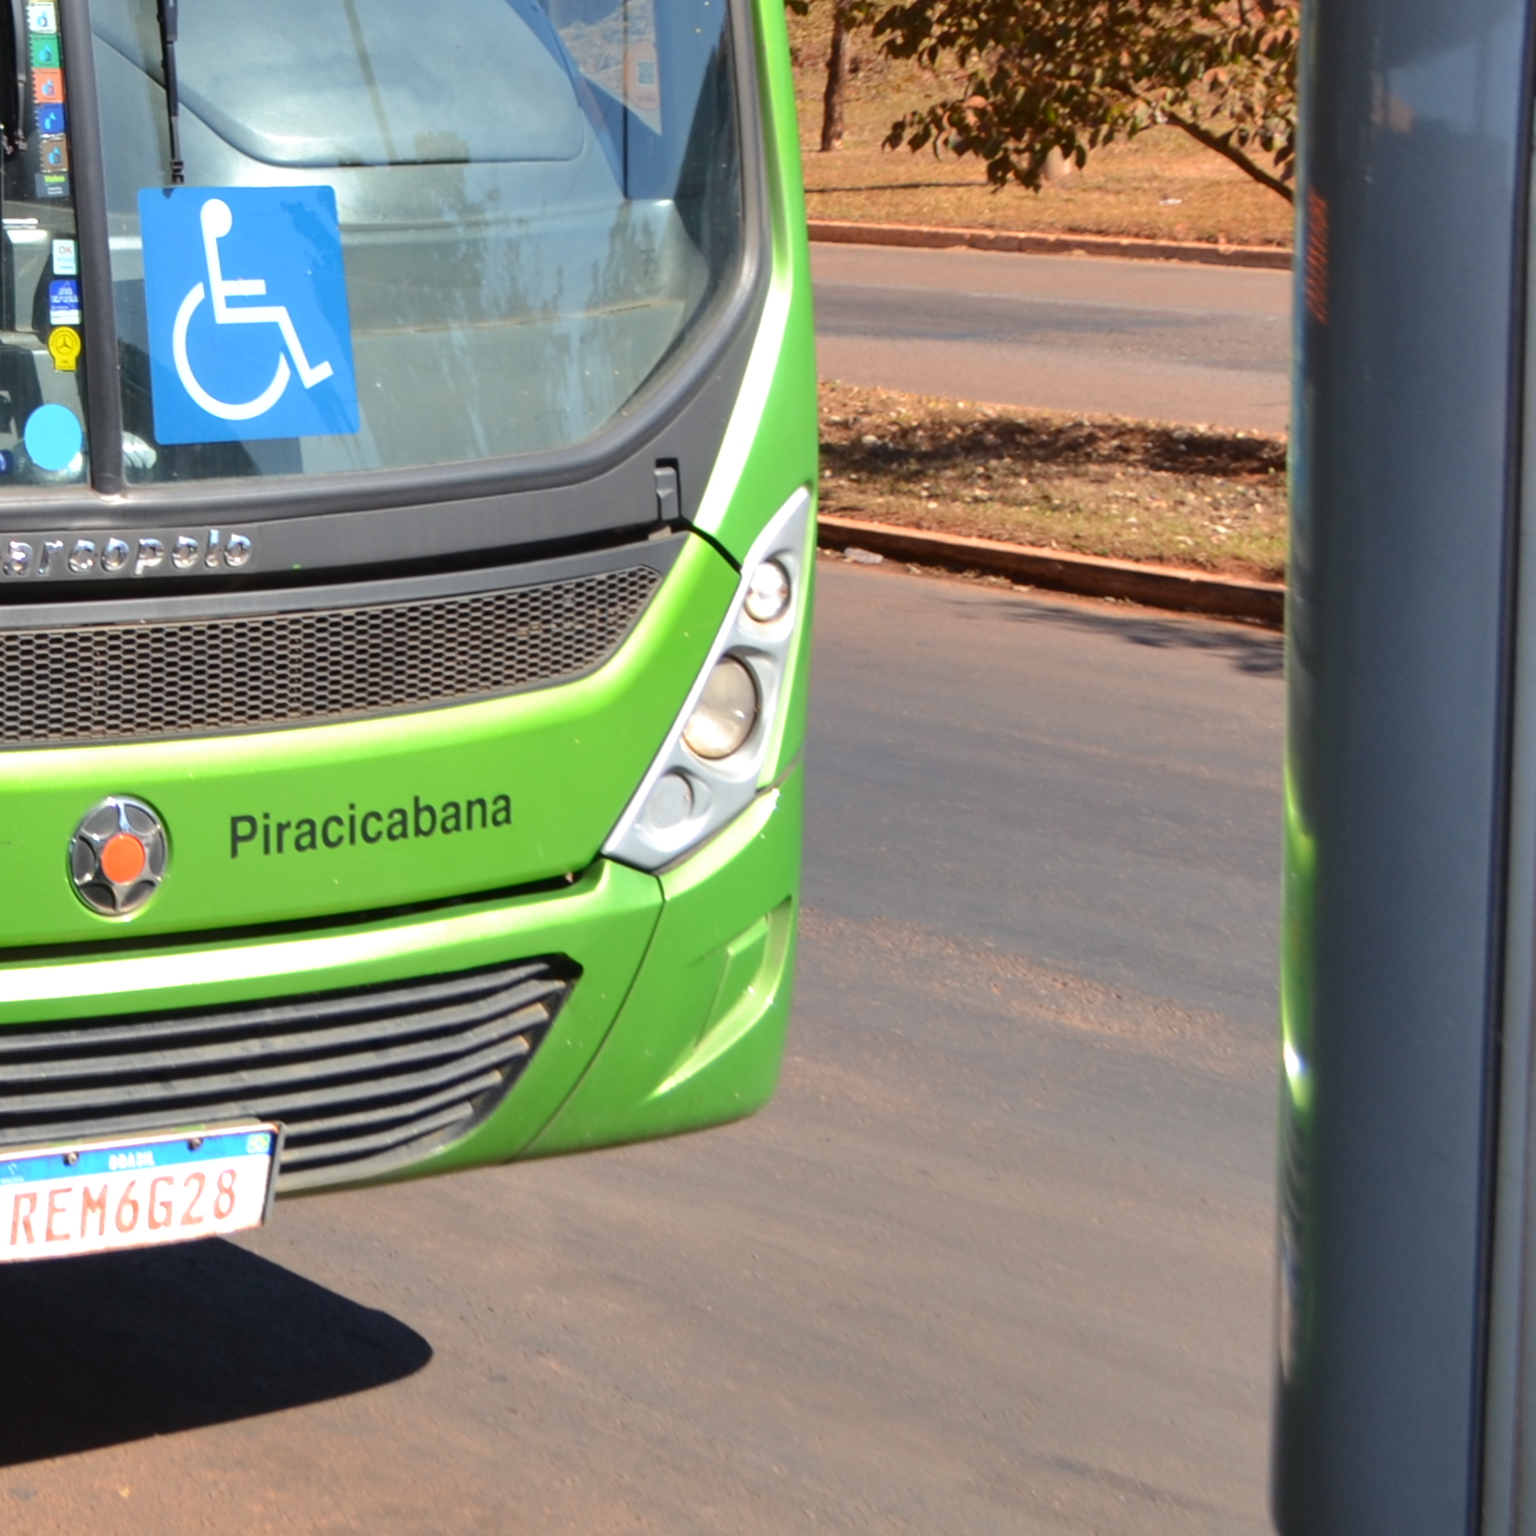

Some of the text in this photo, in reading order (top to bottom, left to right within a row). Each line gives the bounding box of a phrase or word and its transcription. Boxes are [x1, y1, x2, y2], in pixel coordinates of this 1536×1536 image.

[58, 245, 73, 255] OK
[228, 792, 513, 860] Piracicabana
[9, 1167, 238, 1247] REM6G28
